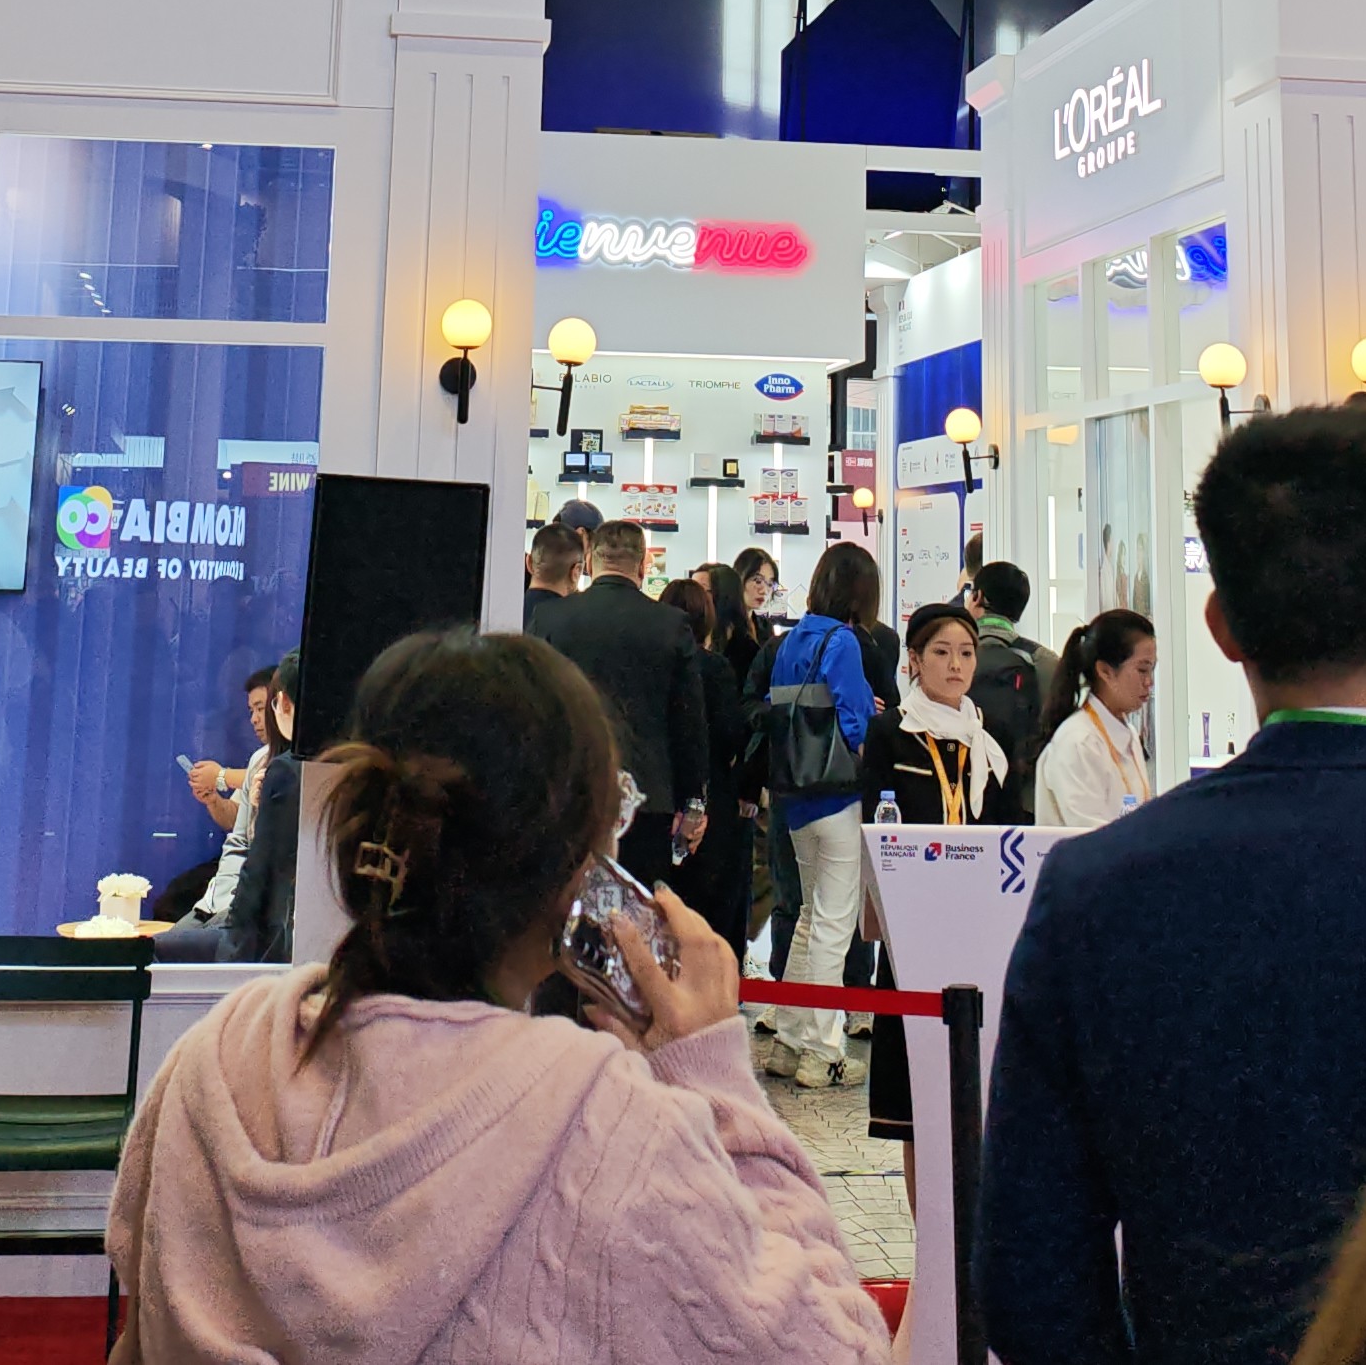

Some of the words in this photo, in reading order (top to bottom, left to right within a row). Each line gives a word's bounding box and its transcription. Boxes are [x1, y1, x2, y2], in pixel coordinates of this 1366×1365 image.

[1054, 59, 1162, 160] L'ORÉAL
[1077, 131, 1135, 178] GROUPE
[535, 210, 807, 267] ienvenue
[689, 380, 741, 390] TRIOMPHE
[768, 375, 791, 385] Inno
[763, 384, 796, 394] Pharm
[945, 843, 984, 852] Business
[945, 852, 976, 860] France
